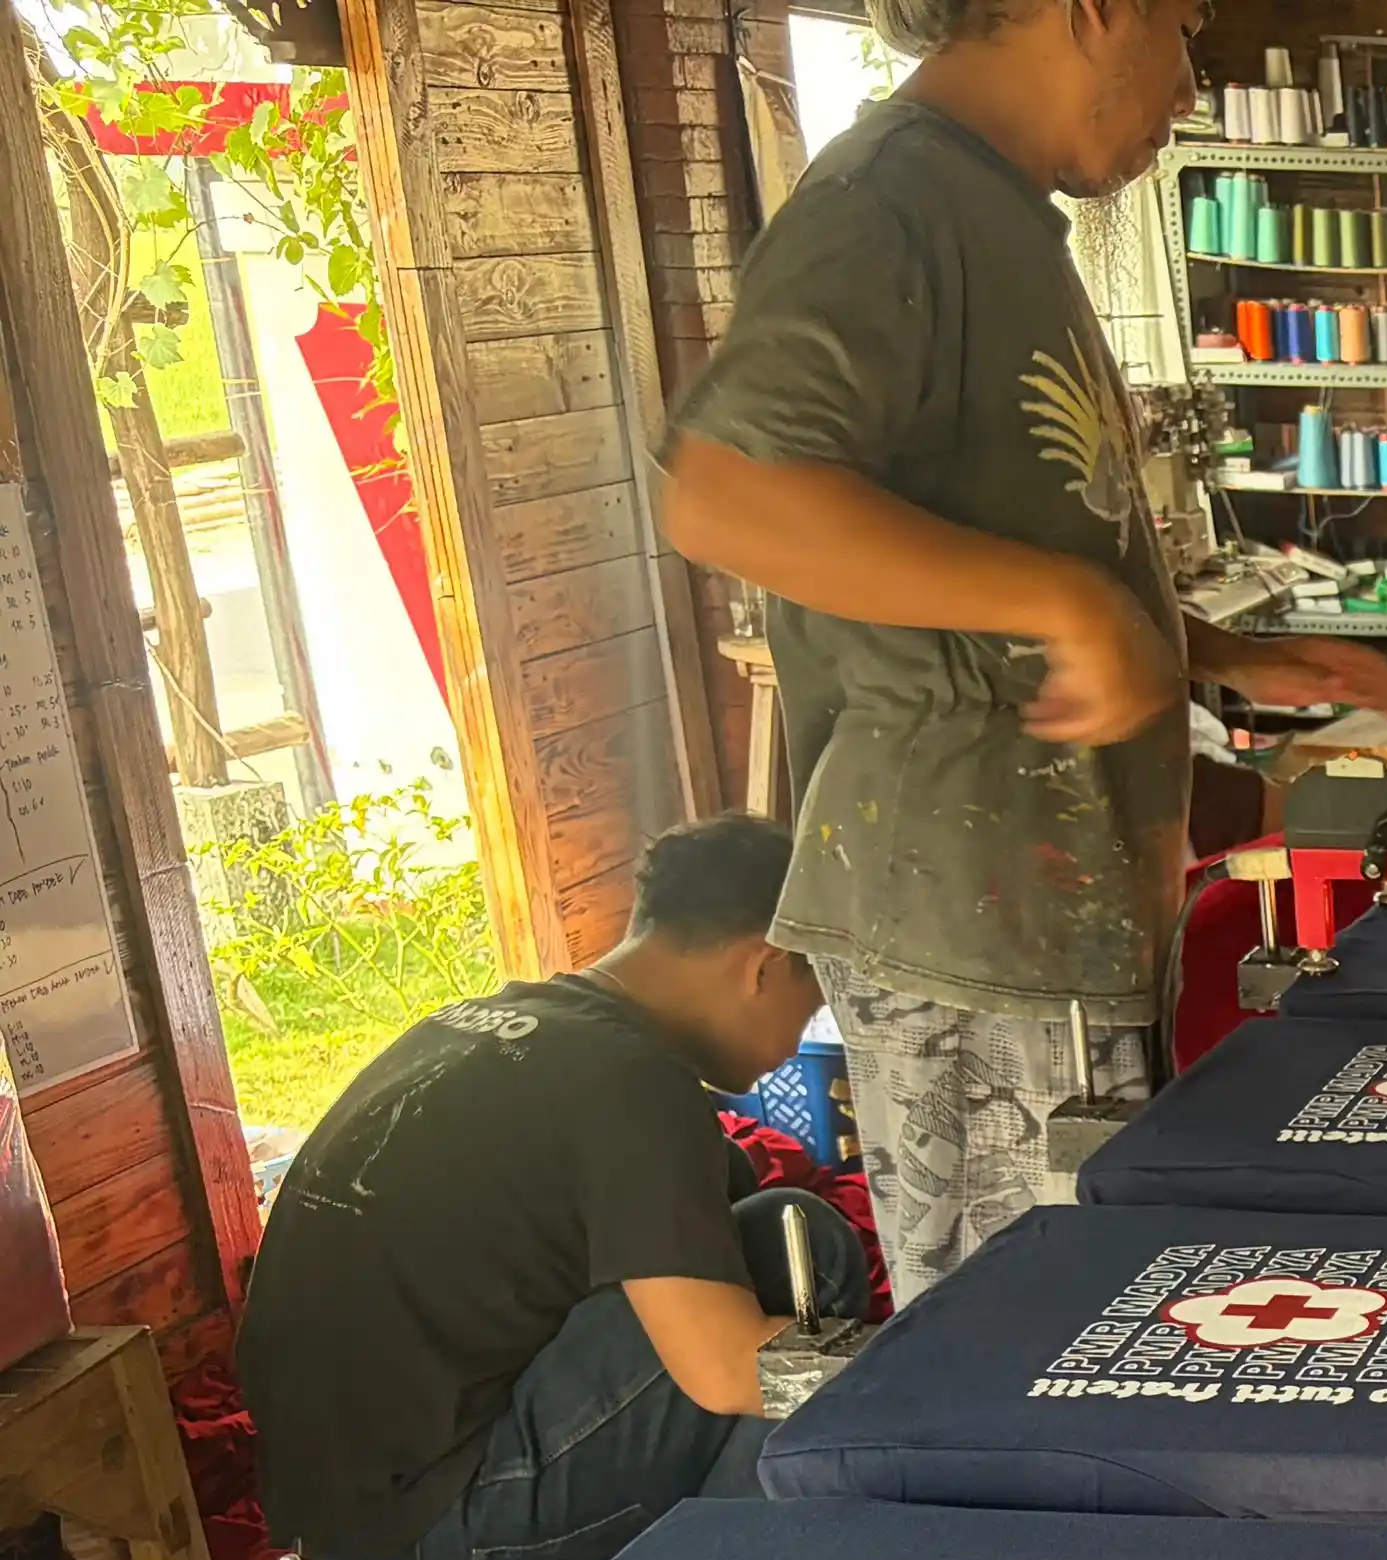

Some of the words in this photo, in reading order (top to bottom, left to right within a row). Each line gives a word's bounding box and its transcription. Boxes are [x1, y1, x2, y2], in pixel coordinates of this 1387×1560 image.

[1044, 1321, 1142, 1373] PMR
[1100, 1243, 1217, 1317] MADYA
[1231, 1343, 1308, 1379] PM
[1024, 1377, 1223, 1402] fratelli
[1231, 1384, 1355, 1405] tutti
